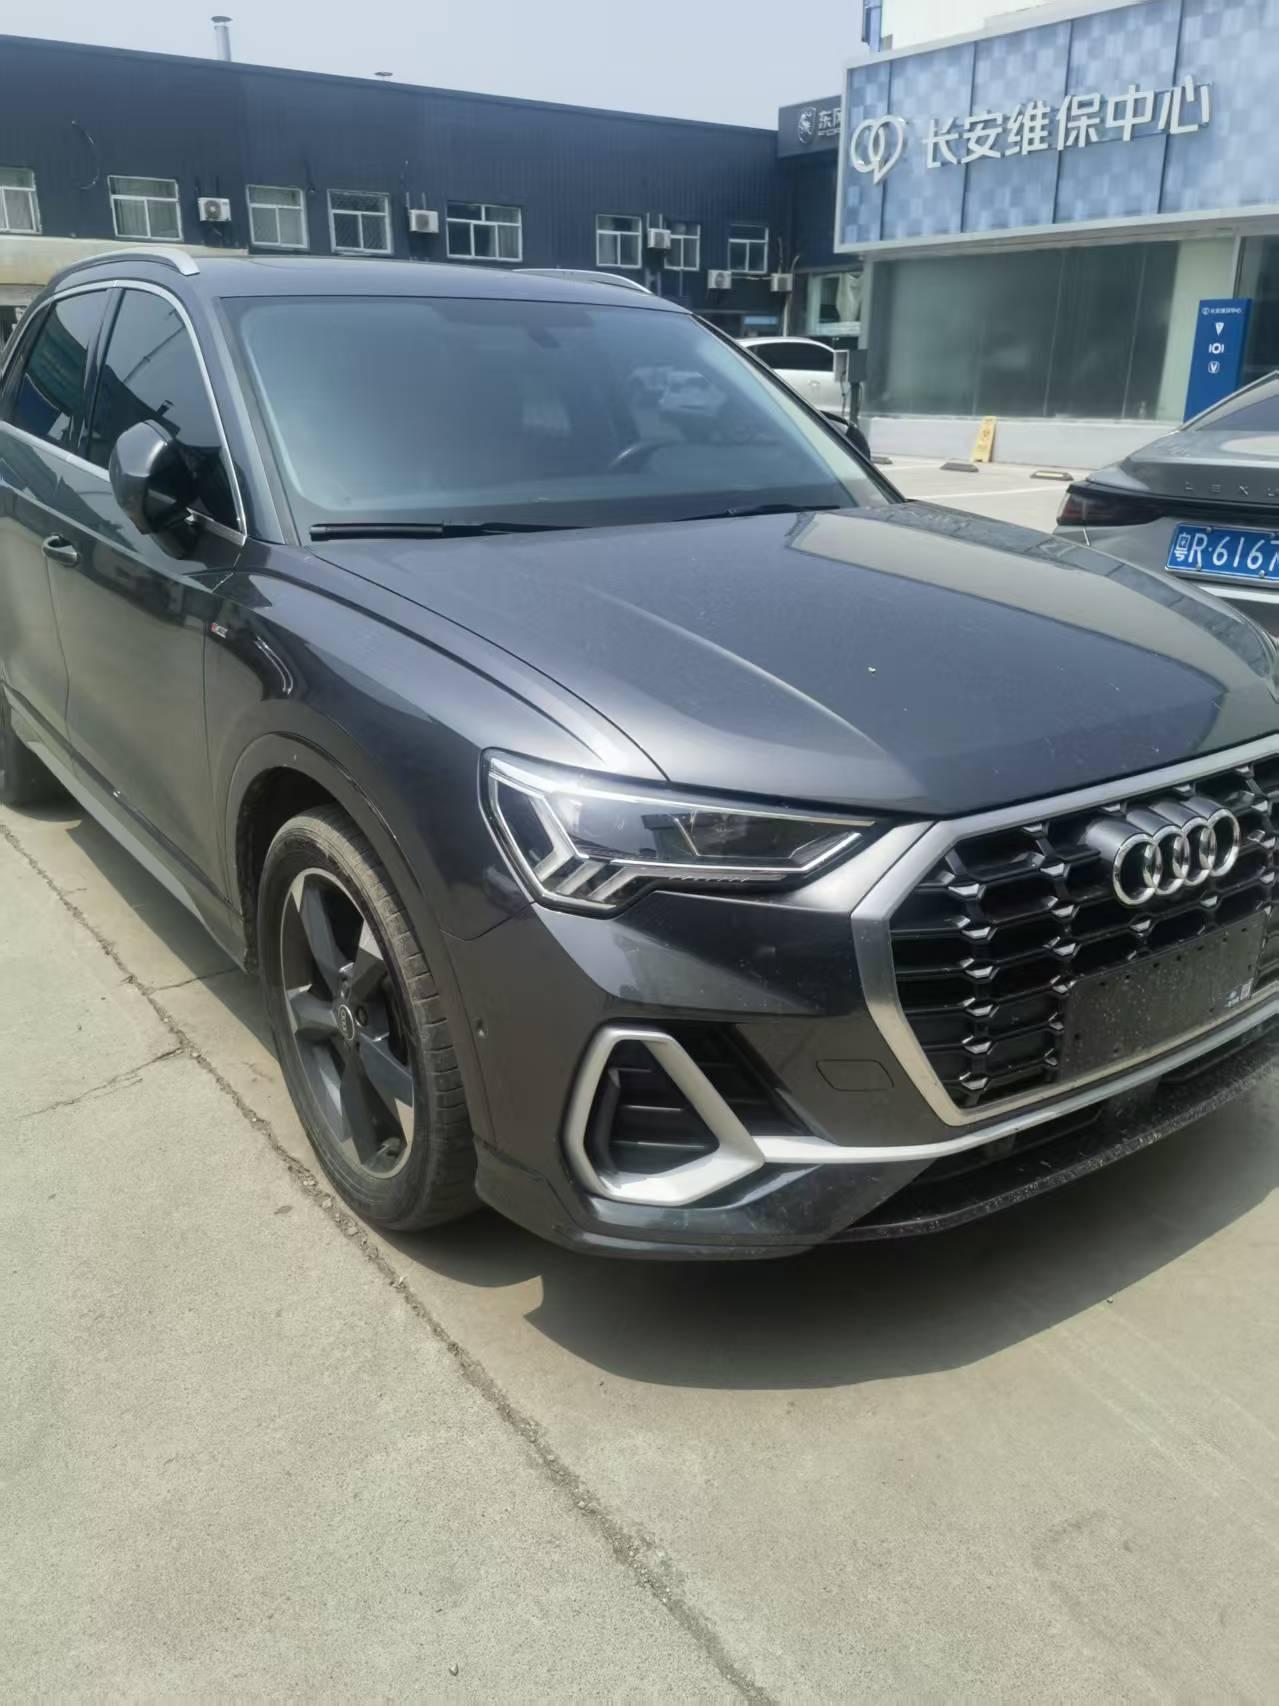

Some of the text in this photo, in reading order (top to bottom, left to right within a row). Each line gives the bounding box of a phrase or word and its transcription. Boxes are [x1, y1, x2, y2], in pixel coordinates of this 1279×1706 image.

[922, 74, 1211, 169] 长安维保中心
